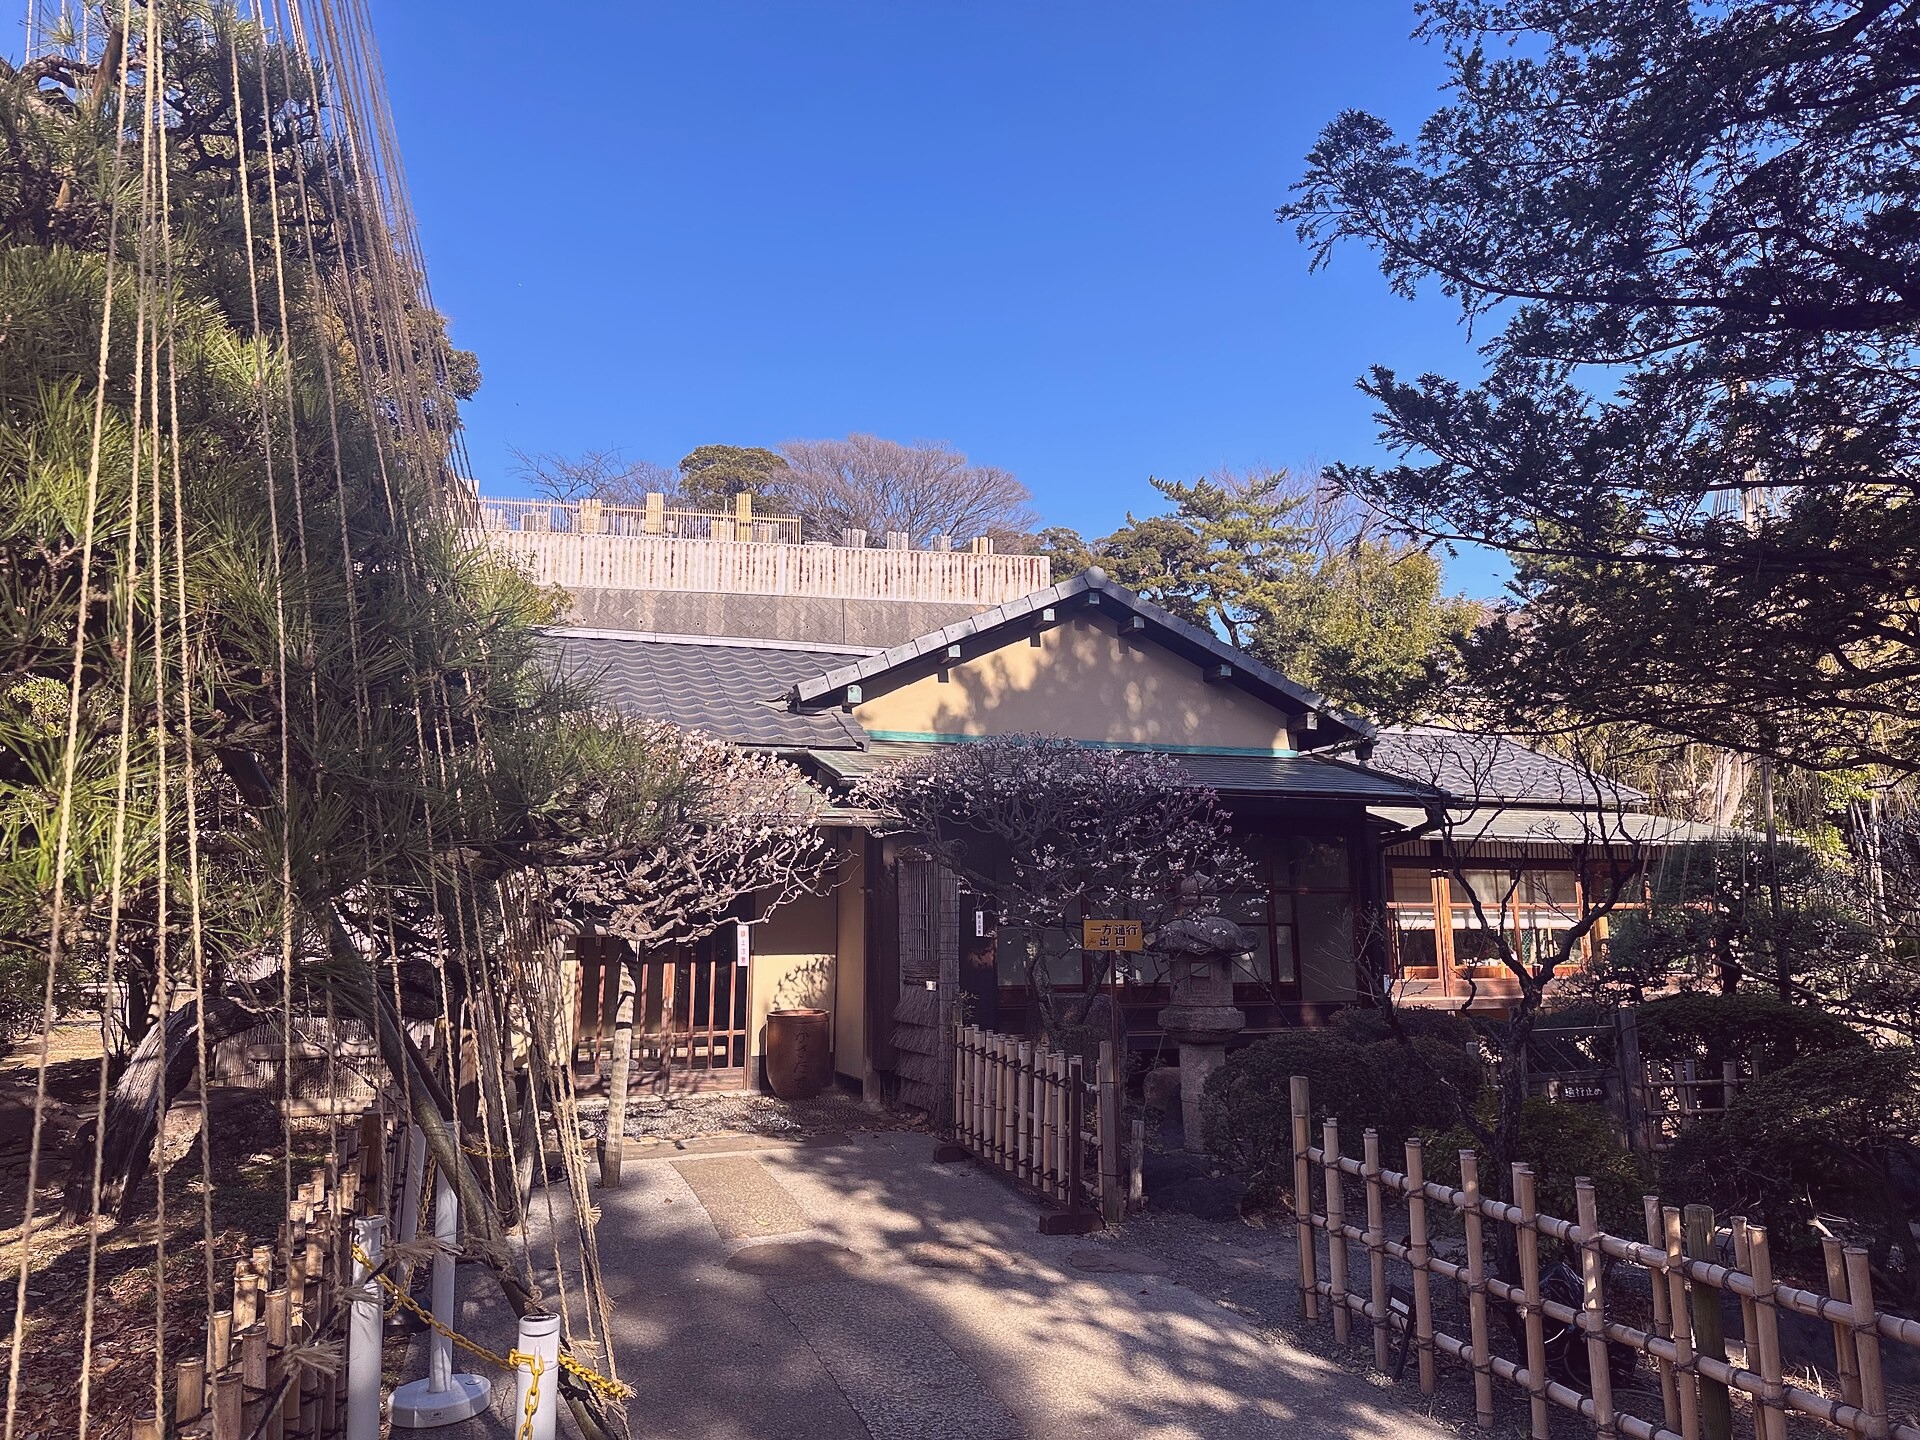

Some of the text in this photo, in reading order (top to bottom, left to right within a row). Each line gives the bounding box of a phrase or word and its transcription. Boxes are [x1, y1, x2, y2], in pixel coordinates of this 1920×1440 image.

[1090, 924, 1138, 936] 一方通行
[1100, 936, 1126, 947] 出口
[1564, 1086, 1603, 1098] 通行止め
